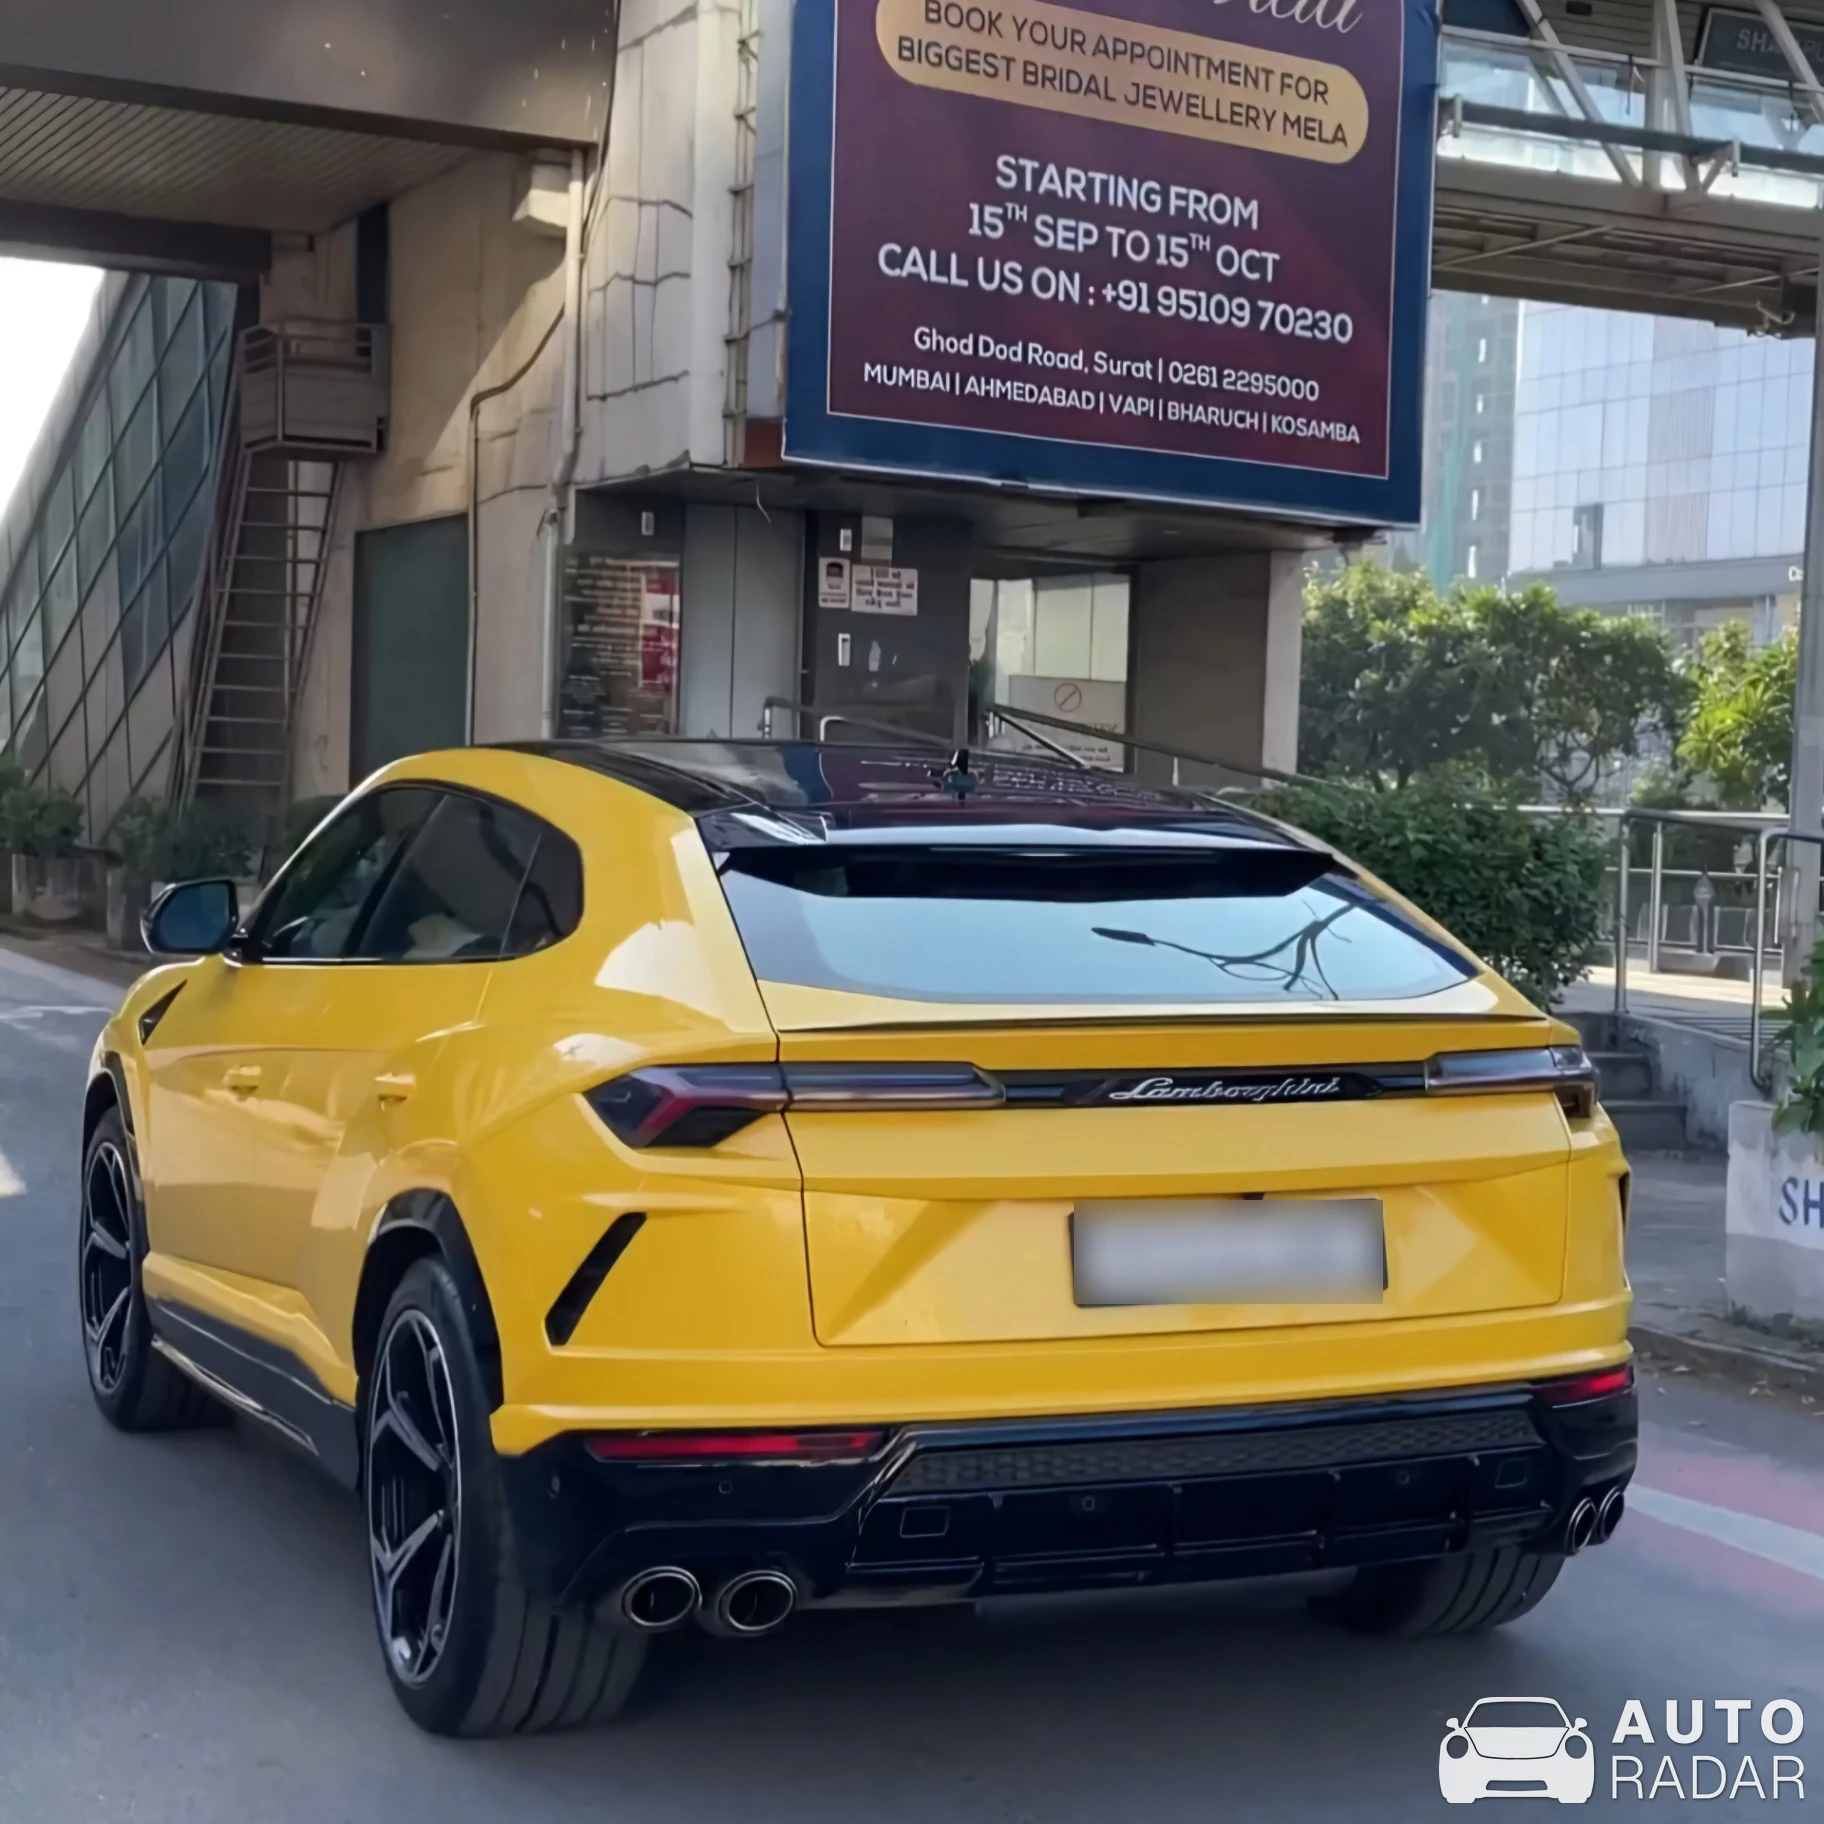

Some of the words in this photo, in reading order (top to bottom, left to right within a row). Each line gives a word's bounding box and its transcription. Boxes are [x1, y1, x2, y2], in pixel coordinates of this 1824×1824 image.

[898, 35, 1016, 82] BIGGEST
[1022, 60, 1117, 102] BRIDAL
[1124, 82, 1277, 132] JEWELLERY
[1282, 111, 1348, 147] MELA
[924, 0, 1003, 38] BOOK
[1012, 15, 1086, 56] YOUR
[1092, 34, 1275, 93] APPOINTMENT
[1279, 72, 1329, 105] FOR
[995, 154, 1162, 213] STARTING
[1169, 185, 1259, 231] FROM
[1034, 214, 1098, 253] SEP
[1105, 225, 1150, 262] TO
[1216, 245, 1280, 283] OCT
[878, 243, 969, 287] CALL
[977, 256, 1024, 295] US
[1031, 266, 1080, 305] ON
[1102, 280, 1150, 314] +91
[1157, 286, 1251, 328] 95109
[1257, 300, 1353, 344] 70230
[863, 362, 950, 393] MUMBAI
[964, 375, 1096, 411] AHMEDABAD
[1108, 393, 1154, 419] VAPI
[1167, 401, 1259, 432] BHARUCH
[1271, 414, 1361, 445] KOSAMBA
[914, 326, 974, 356] Ghod
[978, 334, 1023, 363] Dod
[1027, 342, 1089, 374] Road,
[1093, 350, 1153, 380] Surat
[1168, 361, 1218, 388] 0261
[1222, 368, 1320, 402] 2295000
